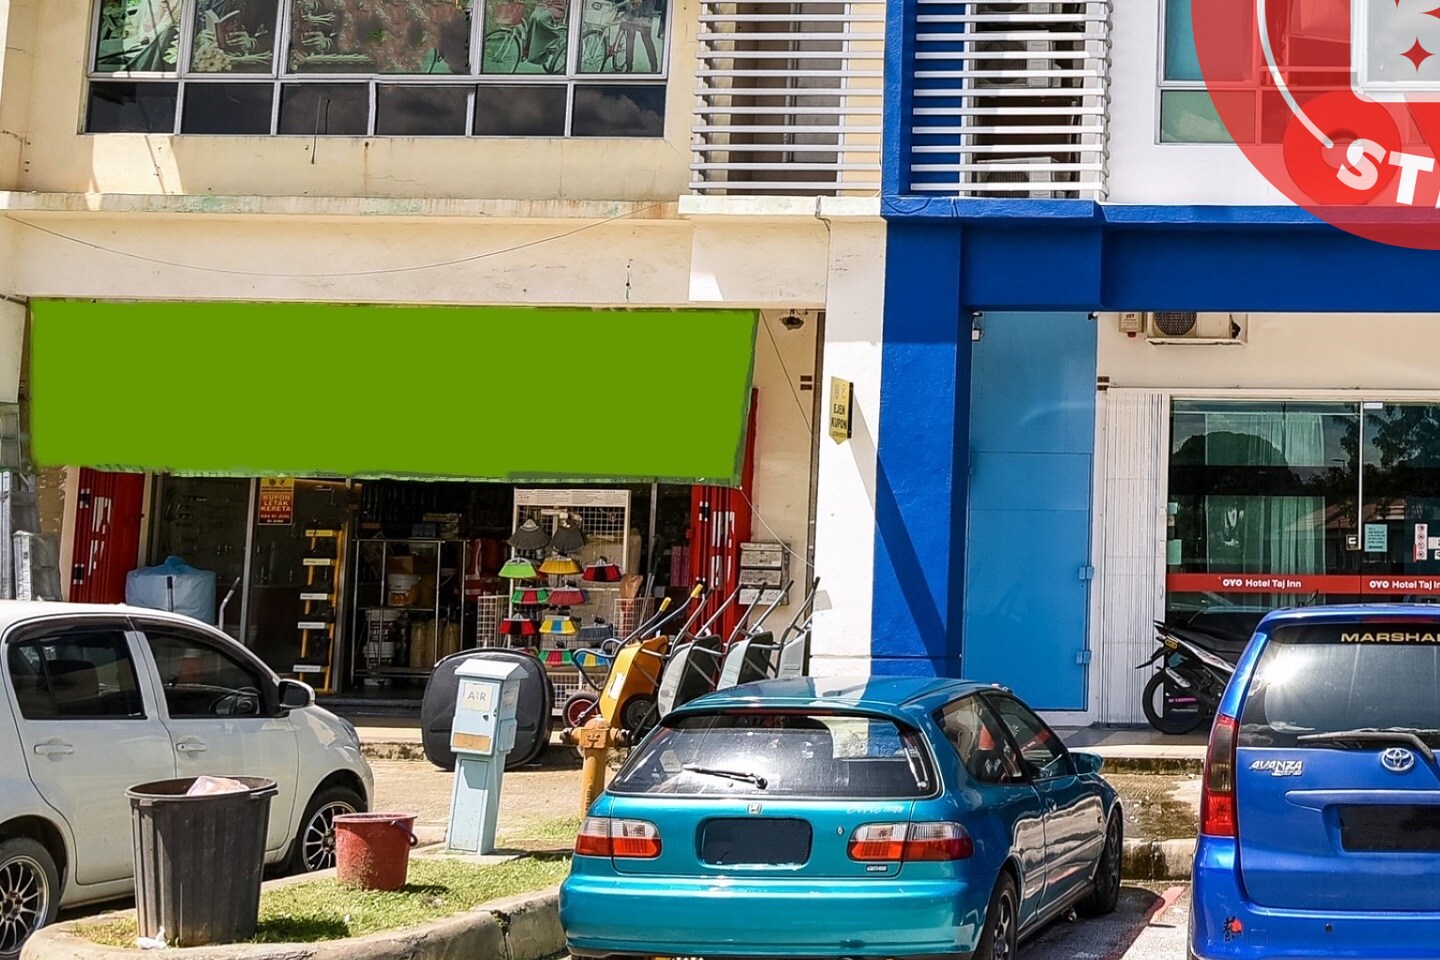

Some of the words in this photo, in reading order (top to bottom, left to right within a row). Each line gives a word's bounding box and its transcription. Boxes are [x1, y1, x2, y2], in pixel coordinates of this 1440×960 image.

[1222, 579, 1243, 587] OYO
[1245, 579, 1270, 587] Hotel
[1271, 579, 1285, 589] Taj
[1286, 579, 1302, 587] Inn
[1369, 580, 1389, 588] OYO
[1392, 580, 1417, 588] Hotel
[1418, 580, 1432, 590] Taj
[1249, 760, 1303, 772] AVANZA
